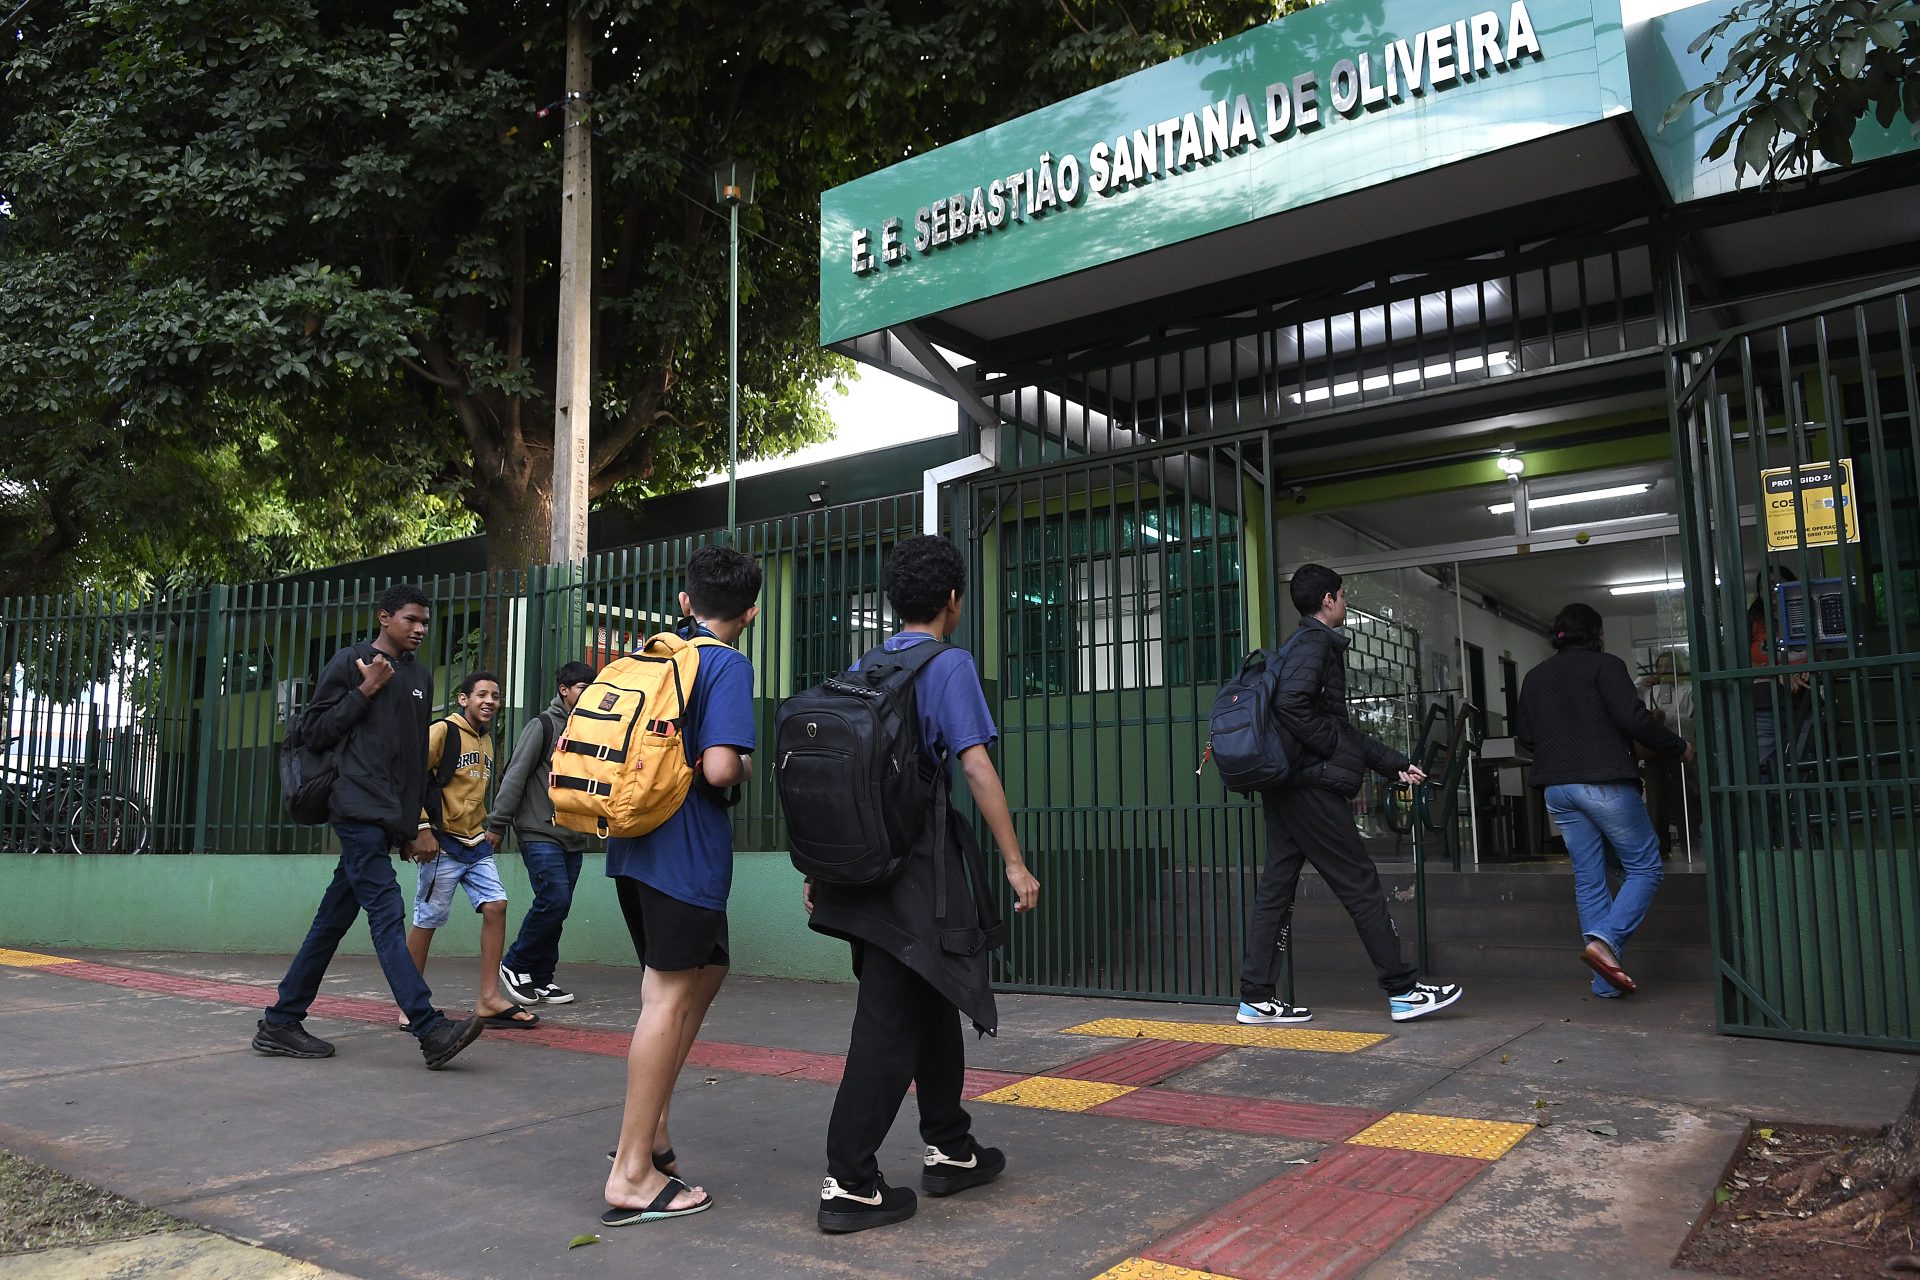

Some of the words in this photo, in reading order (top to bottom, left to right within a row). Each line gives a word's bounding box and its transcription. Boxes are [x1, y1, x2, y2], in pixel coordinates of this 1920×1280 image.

[851, 227, 876, 275] E.
[882, 215, 909, 264] E.
[913, 151, 1083, 254] SEBASTIÃO
[1088, 94, 1259, 195] SANTANA
[1266, 70, 1321, 137] DE
[1330, 0, 1542, 115] OLIVEIRA
[1772, 476, 1821, 487] PROTGIDO
